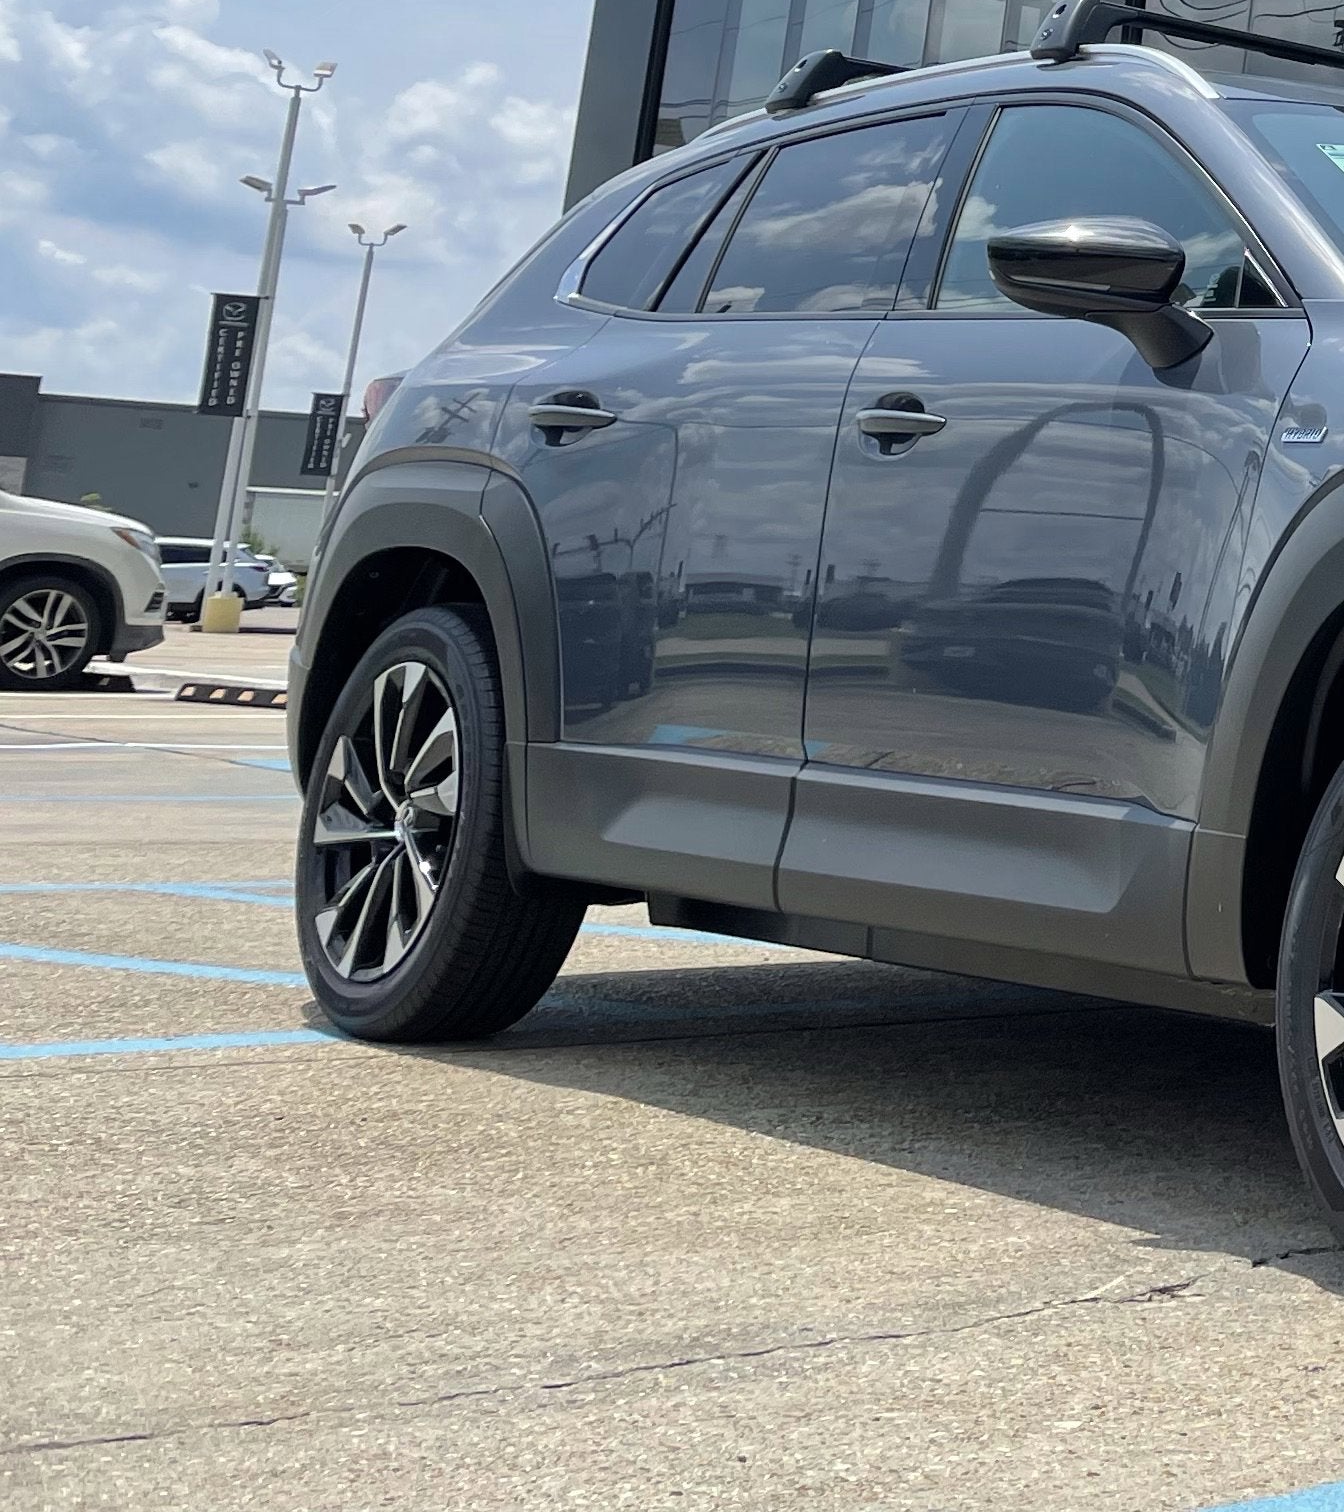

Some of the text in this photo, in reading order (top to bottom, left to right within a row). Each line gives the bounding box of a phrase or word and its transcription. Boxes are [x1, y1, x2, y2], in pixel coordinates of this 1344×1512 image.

[207, 328, 228, 406] CERTIFIED
[226, 361, 241, 405] OWNED
[1283, 428, 1322, 441] HYBRID
